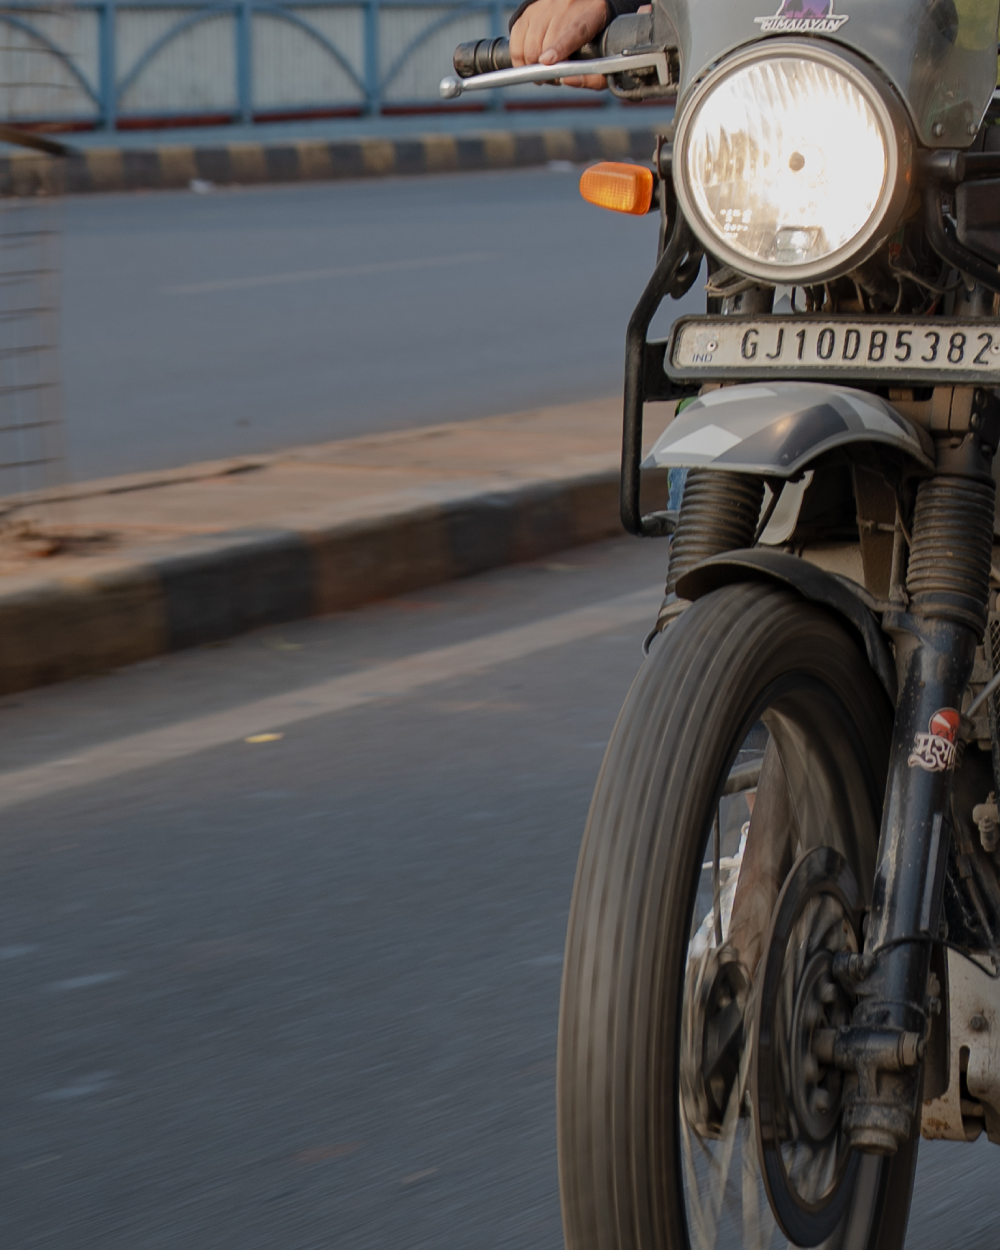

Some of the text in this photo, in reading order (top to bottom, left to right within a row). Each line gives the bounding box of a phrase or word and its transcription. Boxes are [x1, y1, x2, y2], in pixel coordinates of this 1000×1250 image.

[761, 17, 840, 31] HIMALAYAN
[741, 327, 993, 366] GJ10DB5382
[692, 352, 713, 363] IND
